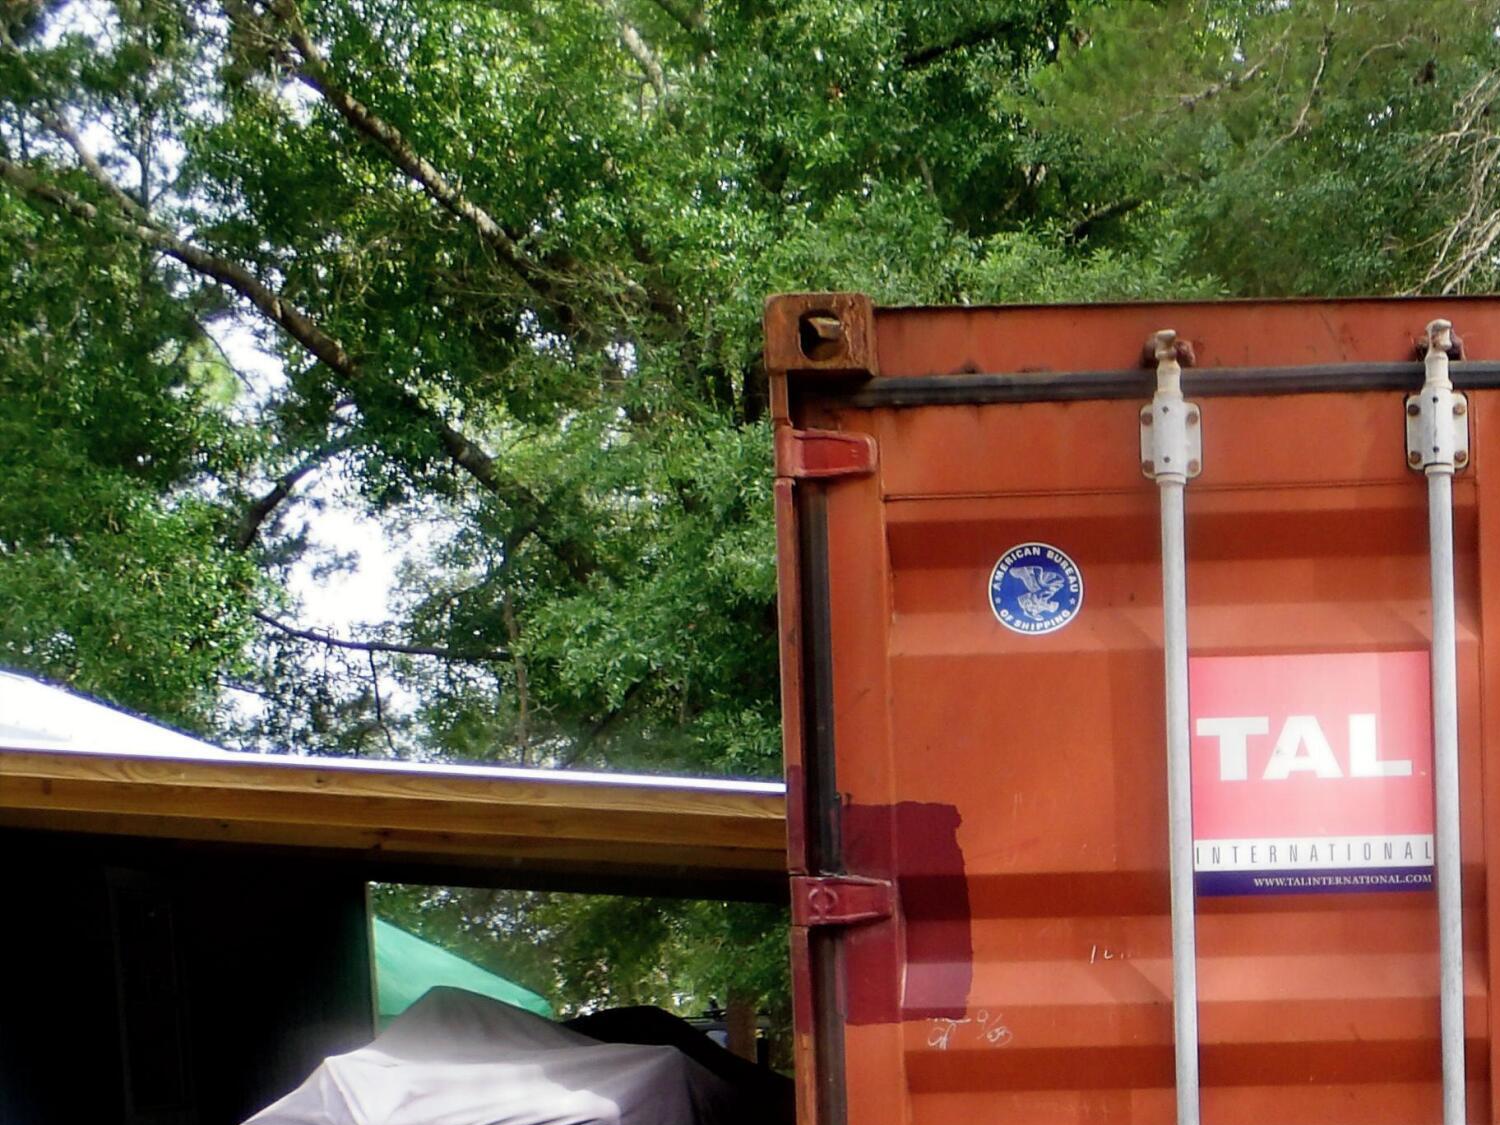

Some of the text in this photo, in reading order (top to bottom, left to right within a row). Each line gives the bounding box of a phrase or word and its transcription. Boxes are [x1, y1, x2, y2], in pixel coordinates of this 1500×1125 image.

[993, 547, 1078, 592] AMERICAN BUREAU
[1000, 609, 1071, 631] OF SHIPPING
[1196, 713, 1413, 782] TAL
[1196, 841, 1432, 865] INTERNATIONAL
[1253, 873, 1432, 888] WWW.TALINTERNATIONAL.COM
